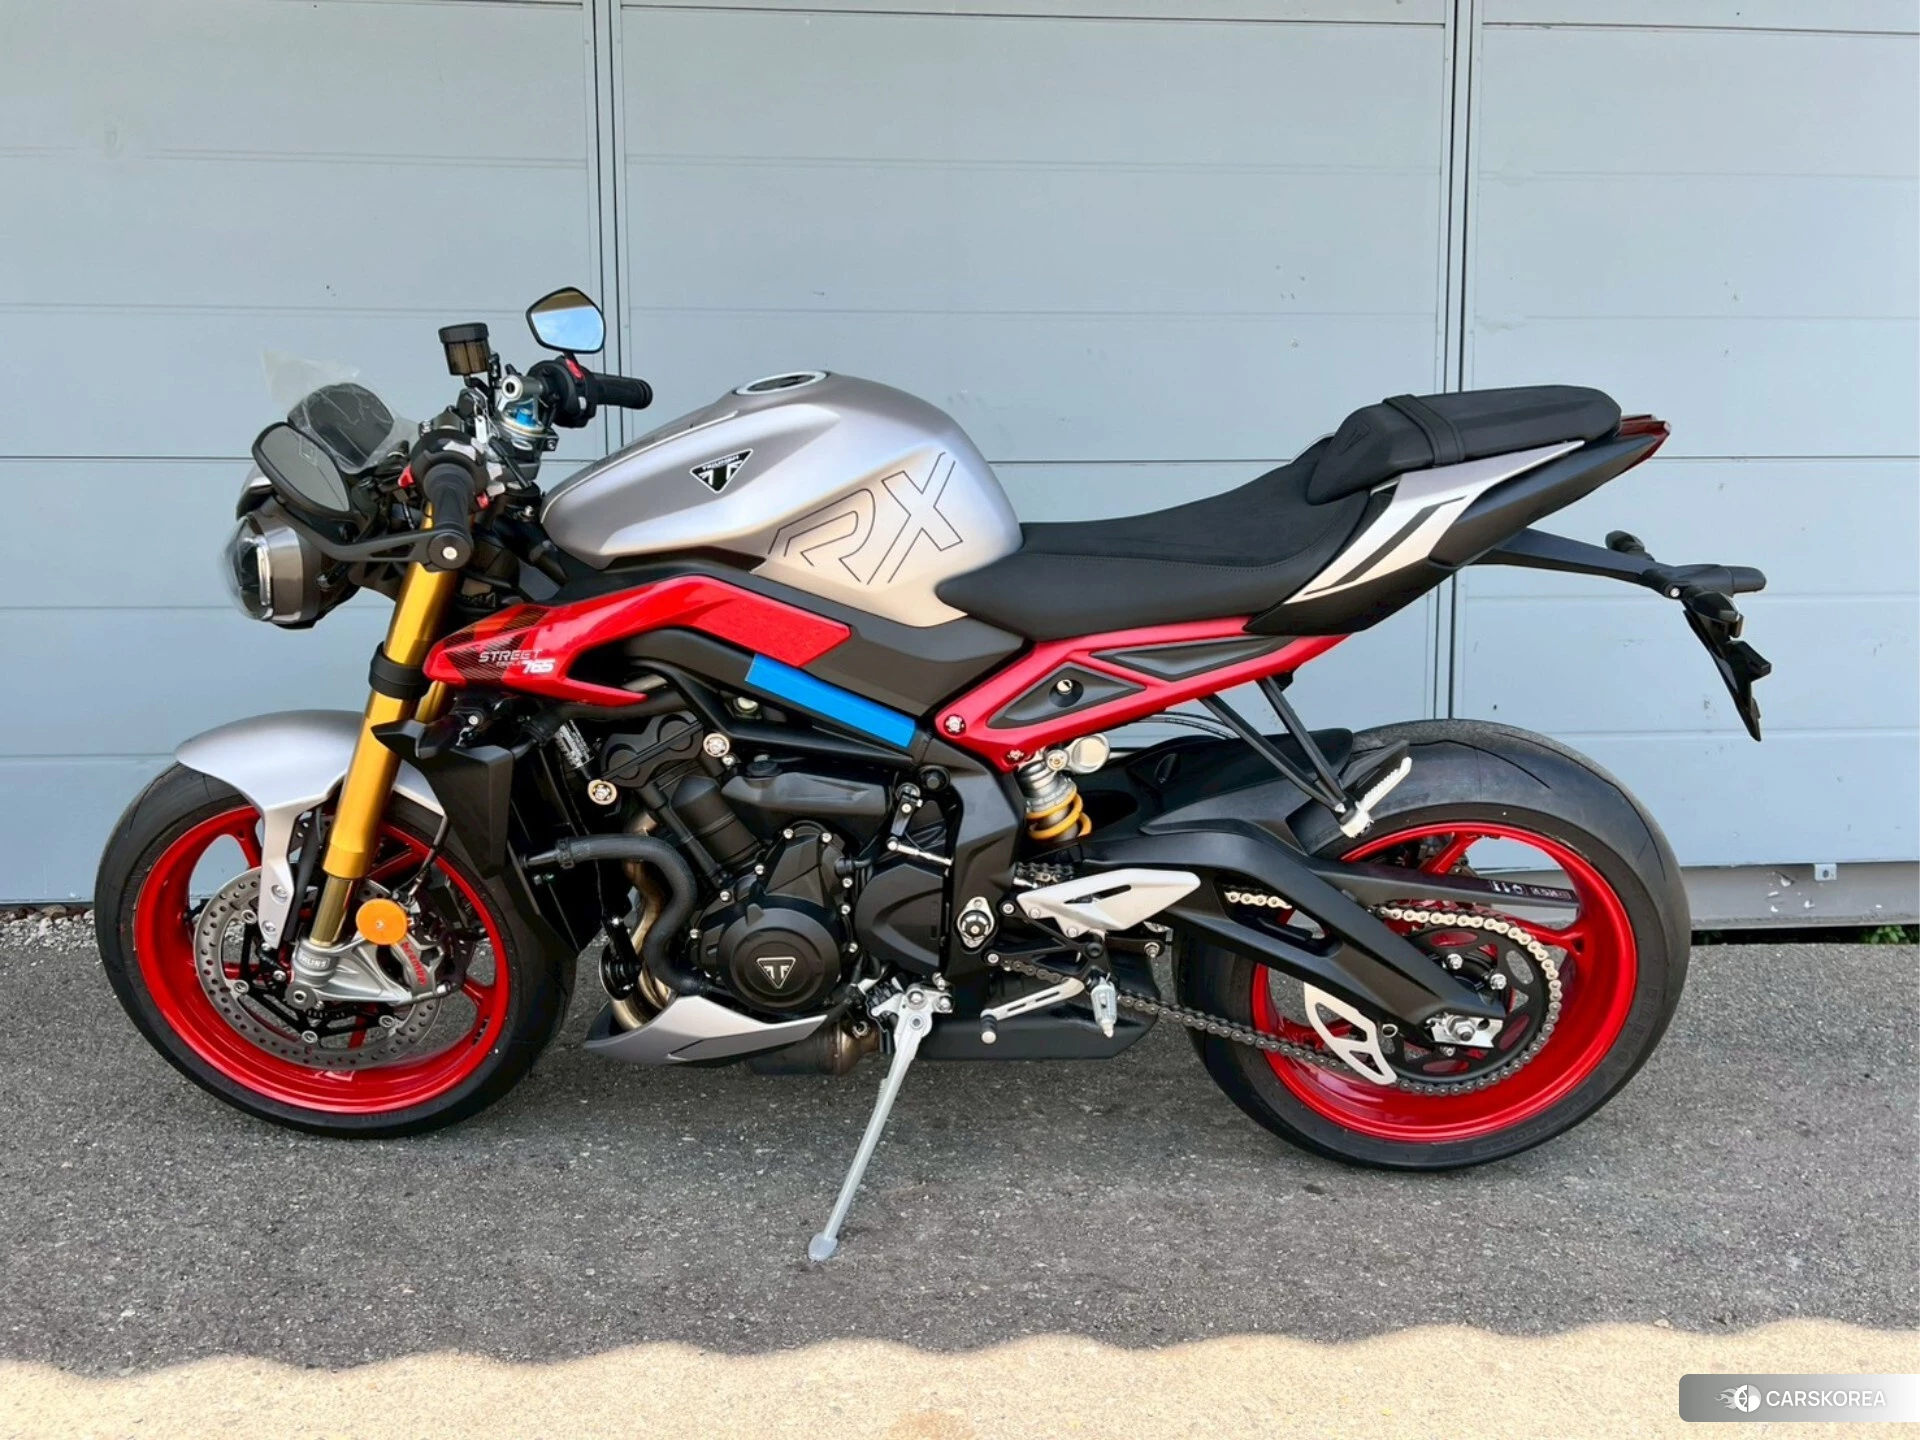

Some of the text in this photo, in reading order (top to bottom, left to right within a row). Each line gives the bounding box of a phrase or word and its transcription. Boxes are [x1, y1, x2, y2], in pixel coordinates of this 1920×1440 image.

[767, 451, 964, 586] RX
[478, 648, 544, 663] STREET
[521, 658, 557, 675] 765
